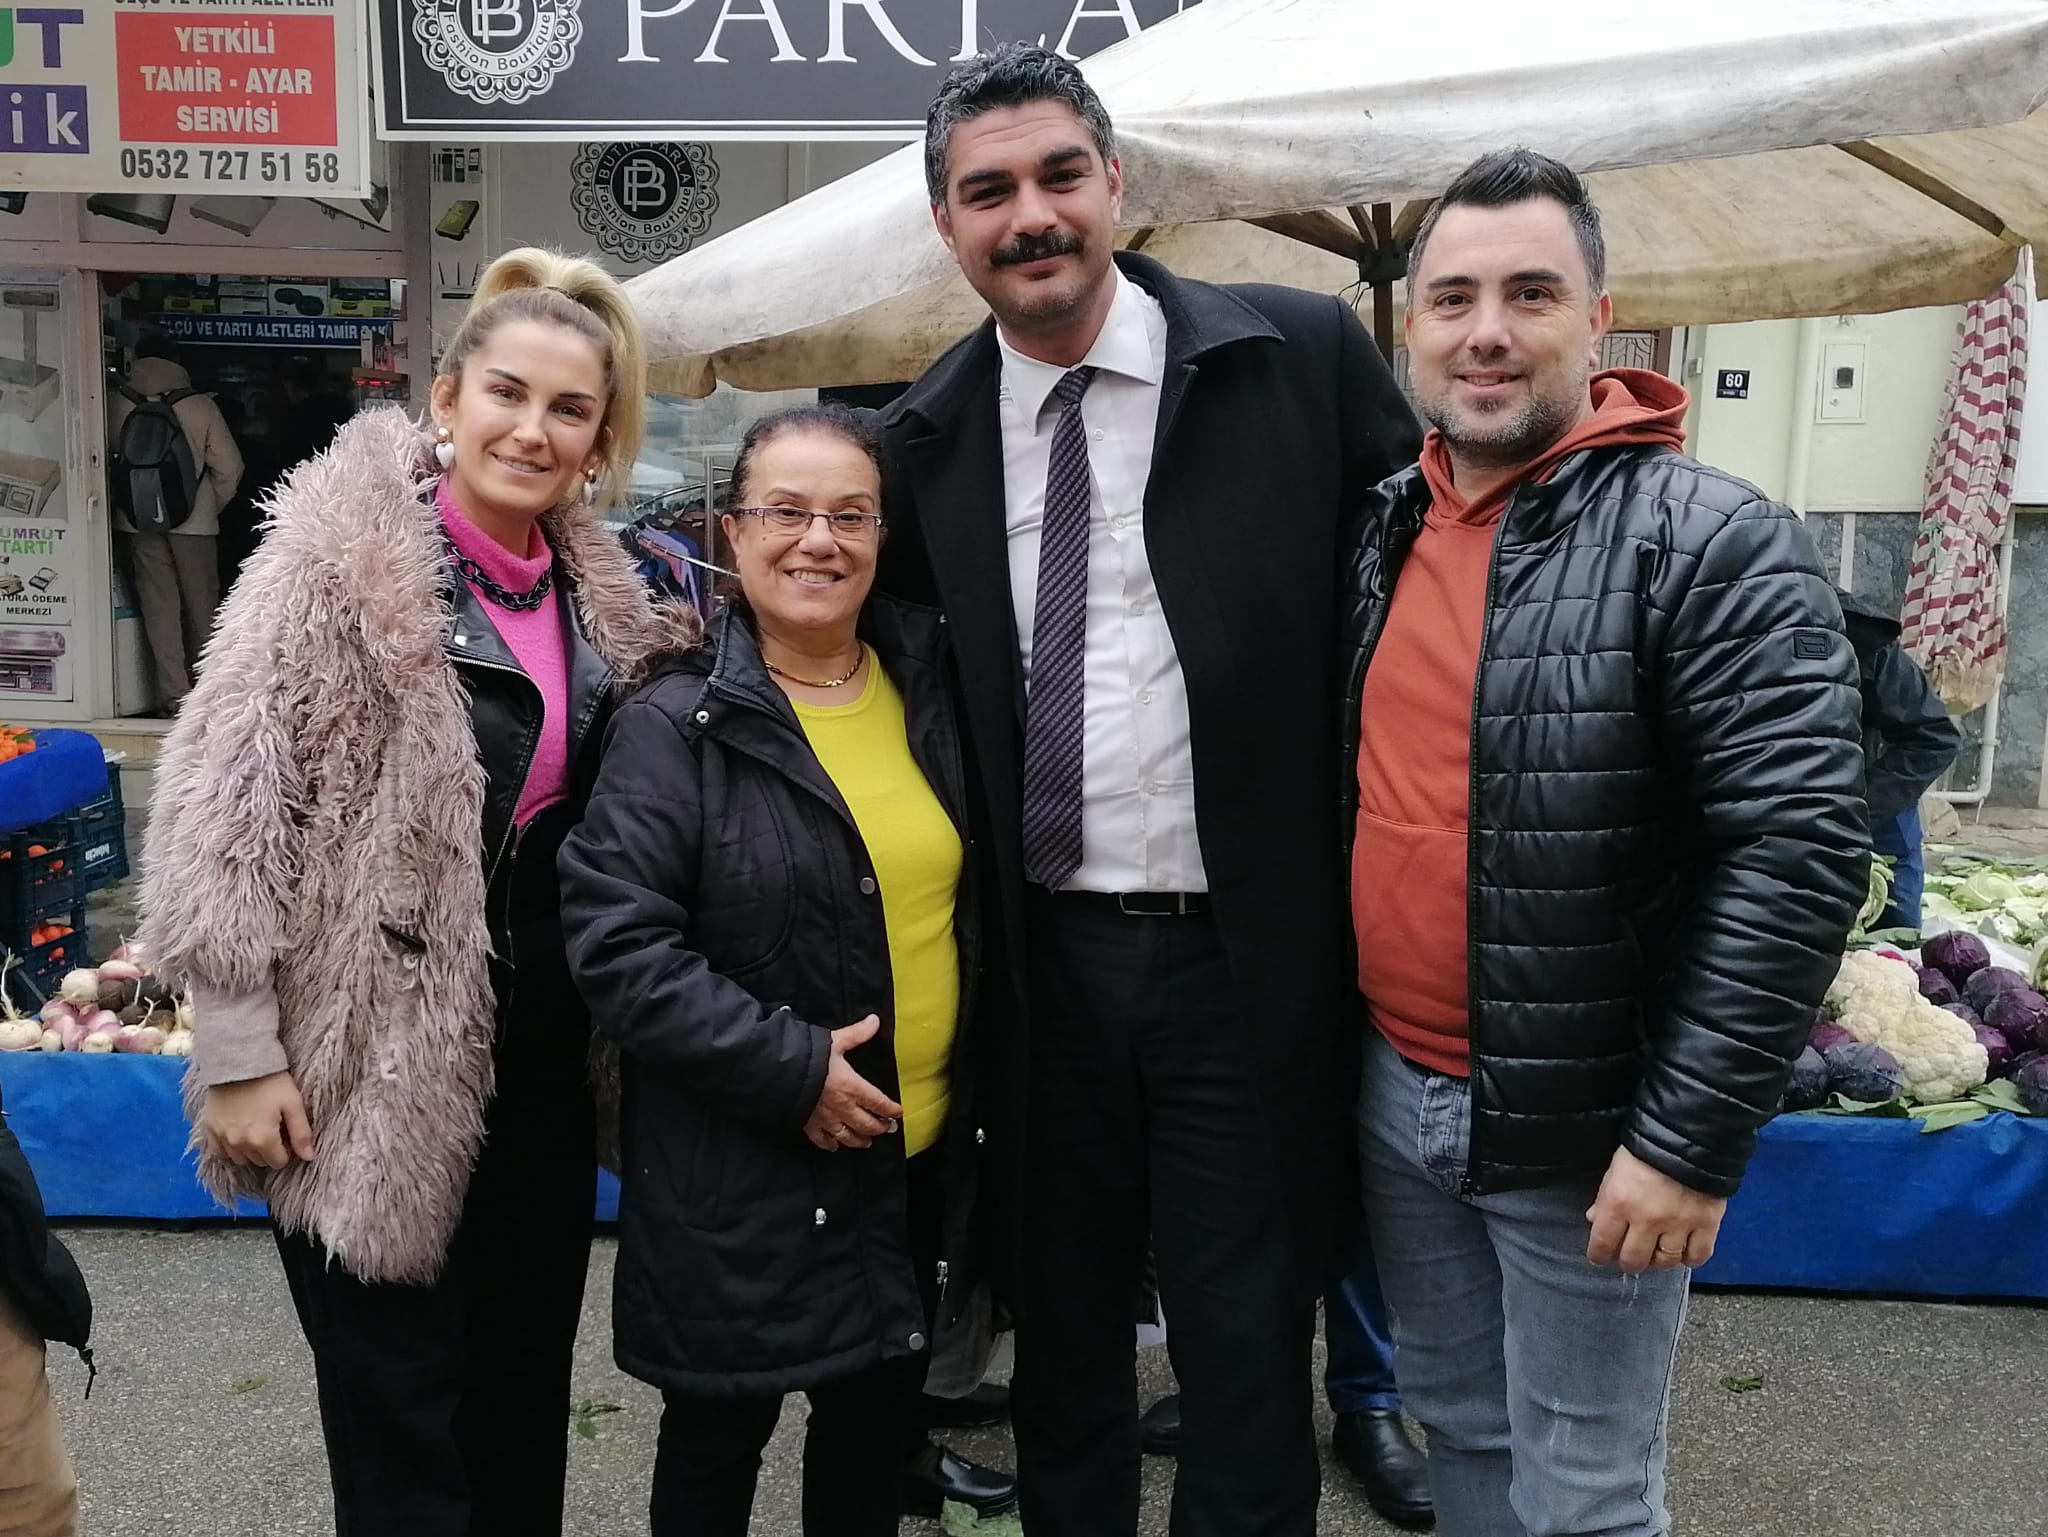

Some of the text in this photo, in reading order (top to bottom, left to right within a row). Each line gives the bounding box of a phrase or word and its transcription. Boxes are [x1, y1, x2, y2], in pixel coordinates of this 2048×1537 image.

[174, 20, 275, 55] YETKİLİ
[443, 14, 551, 70] Fashion Boutique
[140, 60, 222, 93] TAMİR
[245, 67, 313, 95] AYAR
[176, 100, 279, 133] SERVİSİ
[120, 148, 339, 183] 0532 727 51 58
[600, 186, 692, 234] Fashion Boutique
[196, 321, 213, 336] VE
[215, 321, 252, 337] TARTI
[256, 320, 315, 339] ALETLERİ
[317, 321, 358, 340] TAMİR
[1725, 373, 1744, 389] 60
[0, 539, 54, 555] TARTI
